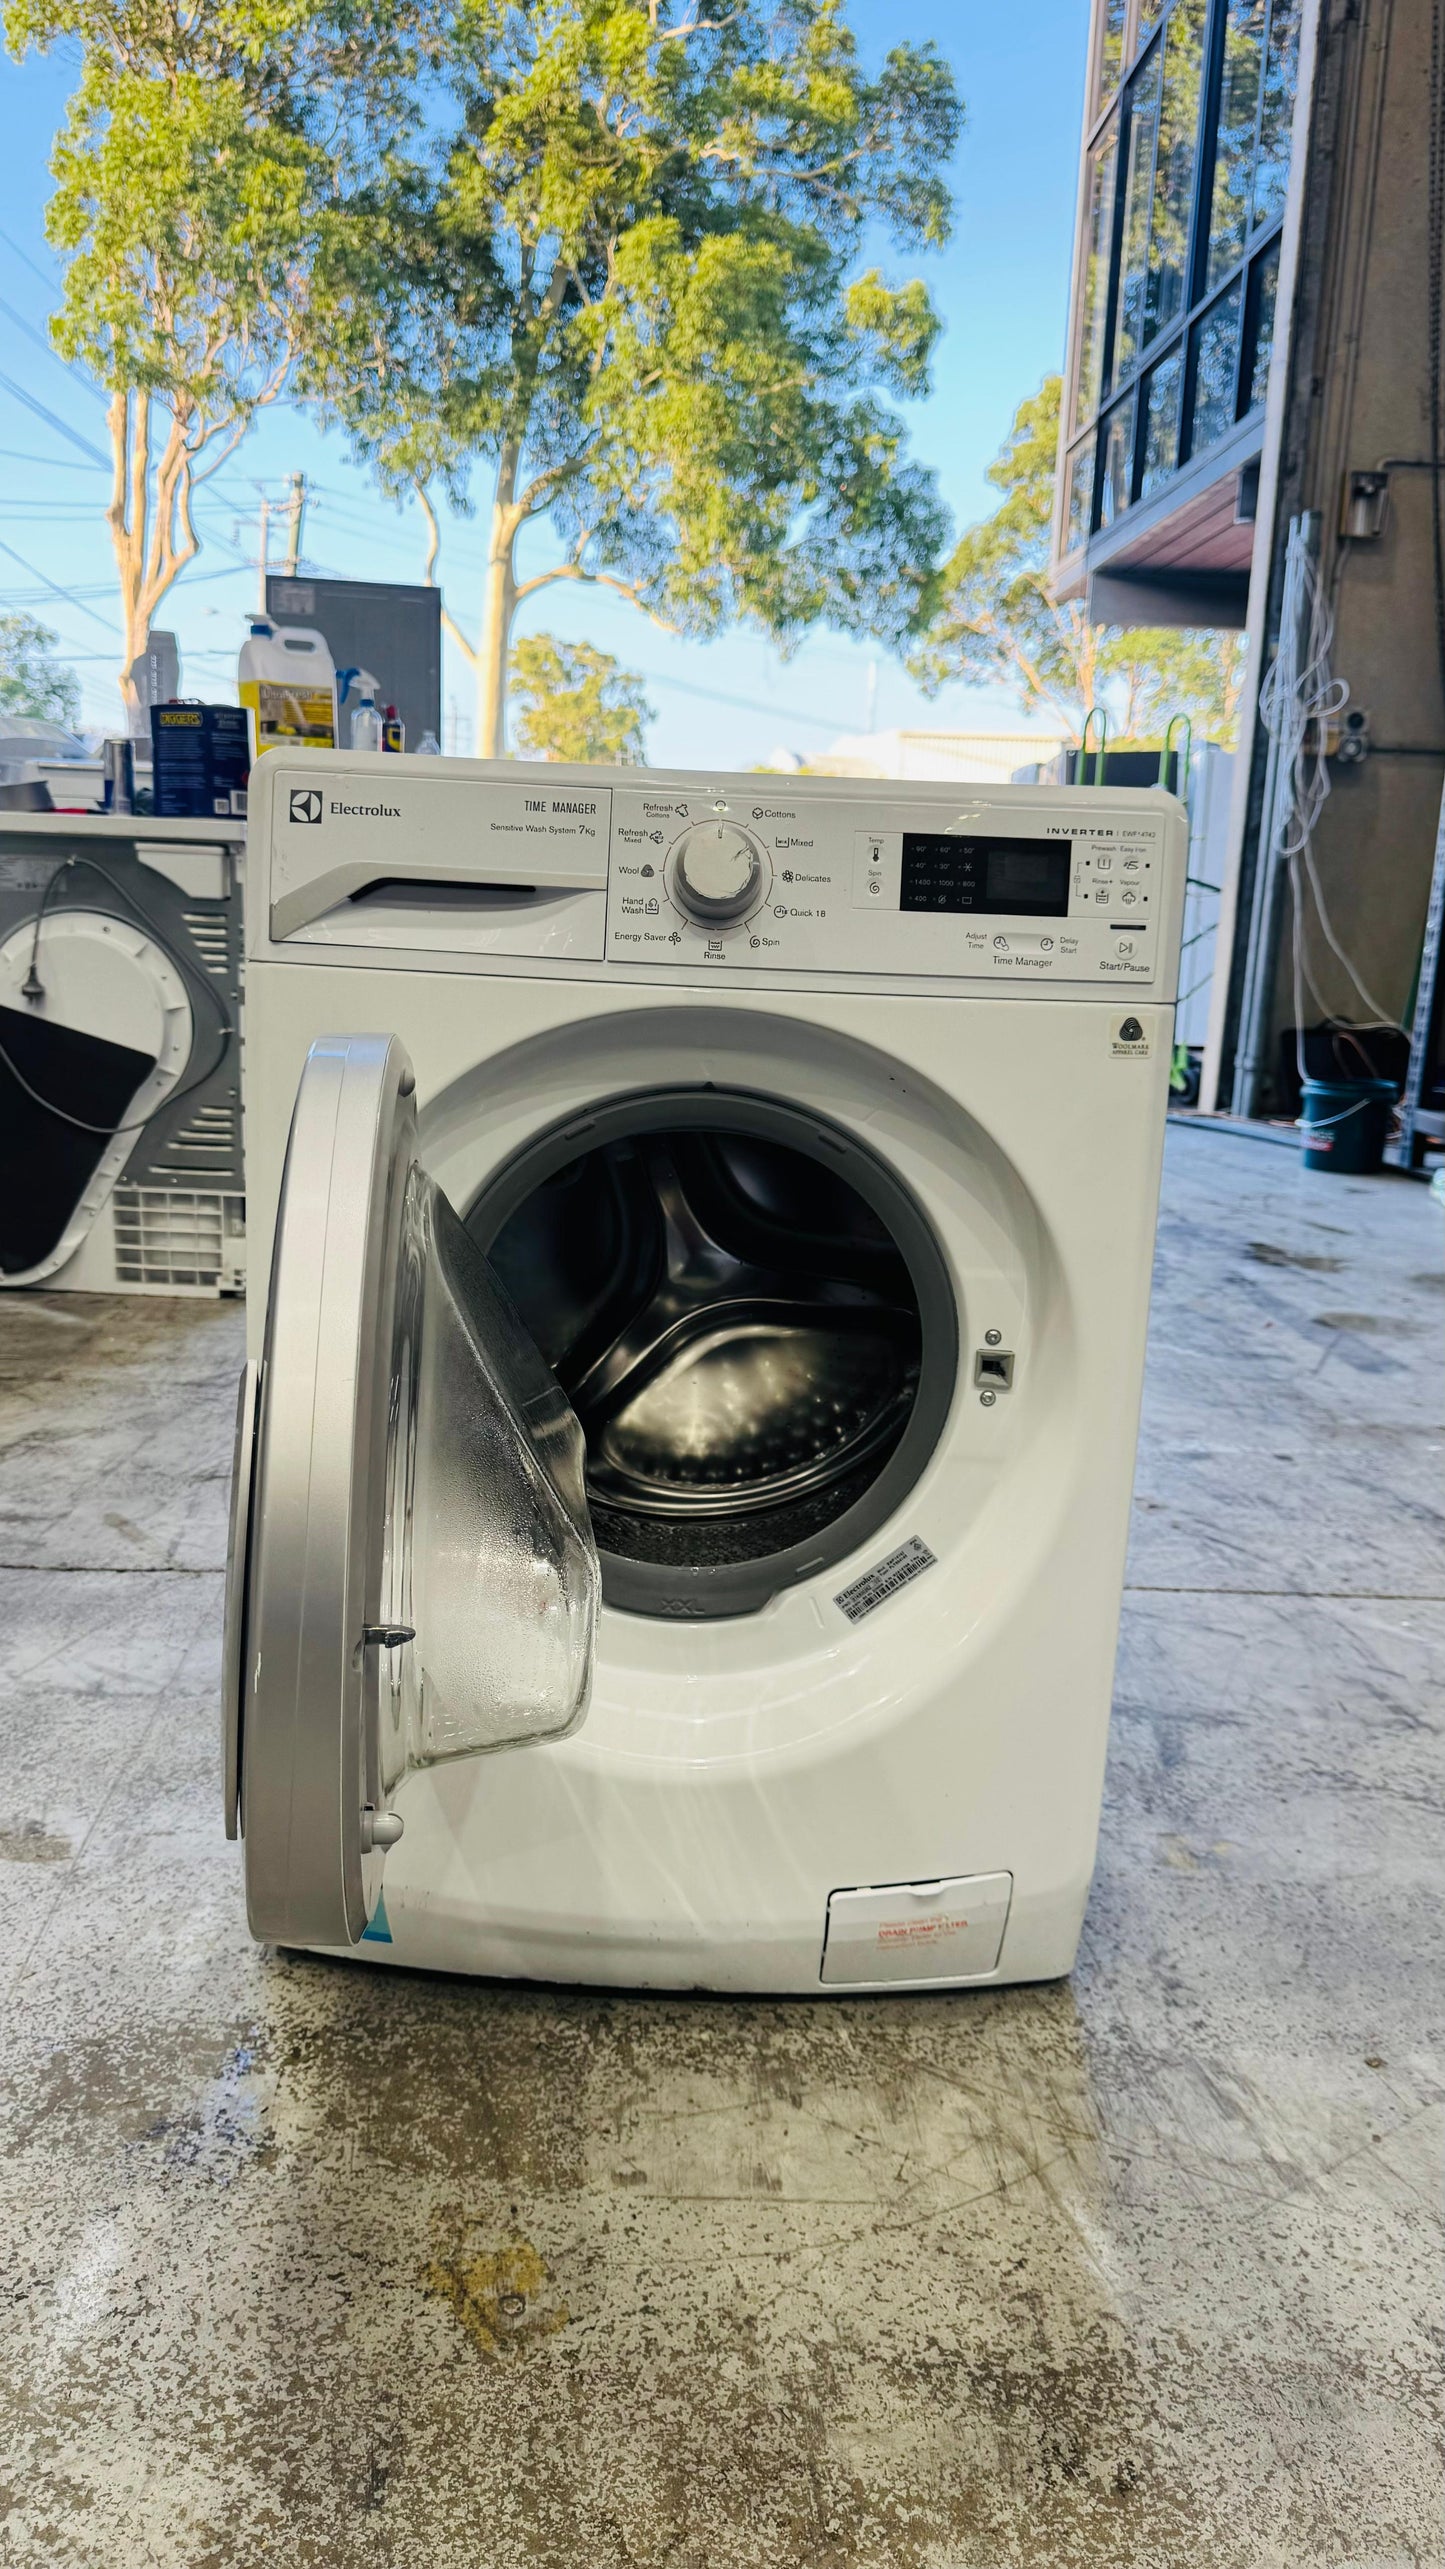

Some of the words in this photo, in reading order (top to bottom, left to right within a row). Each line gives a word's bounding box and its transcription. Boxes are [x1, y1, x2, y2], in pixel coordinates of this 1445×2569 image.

[330, 801, 402, 818] Electrolux
[524, 800, 547, 813] TIME
[552, 801, 597, 815] MANAGER
[643, 803, 674, 812] Refresh
[646, 811, 671, 819] Cottons
[764, 809, 796, 819] Cottons
[490, 823, 524, 833] Sensitive
[525, 824, 548, 834] Wash
[548, 825, 577, 836] System
[578, 825, 596, 837] 7Kg
[618, 828, 649, 838] Refresh
[1046, 828, 1114, 837] INVERTER
[790, 838, 814, 848] Mixed
[868, 837, 885, 846] Temp
[1120, 845, 1134, 853] Easy
[618, 866, 639, 875] Wool
[867, 869, 882, 878] Spin
[795, 873, 832, 883] Delicates
[622, 897, 644, 906] Hand
[621, 905, 644, 915] Wash
[790, 908, 814, 918] Quick
[816, 909, 826, 918] 18
[614, 933, 642, 943] Energy
[643, 933, 667, 942] Saver
[965, 932, 988, 941] Adjust
[1060, 936, 1079, 946] Delay
[761, 937, 780, 948] Spin
[968, 942, 985, 950] Time
[1060, 946, 1078, 954] Start
[703, 951, 726, 961] Rinse
[993, 956, 1013, 966] Time
[1015, 957, 1053, 969] Manager
[1099, 961, 1150, 973] Start/Pause
[842, 1574, 876, 1599] Electrolux
[658, 1598, 705, 1615] XXL
